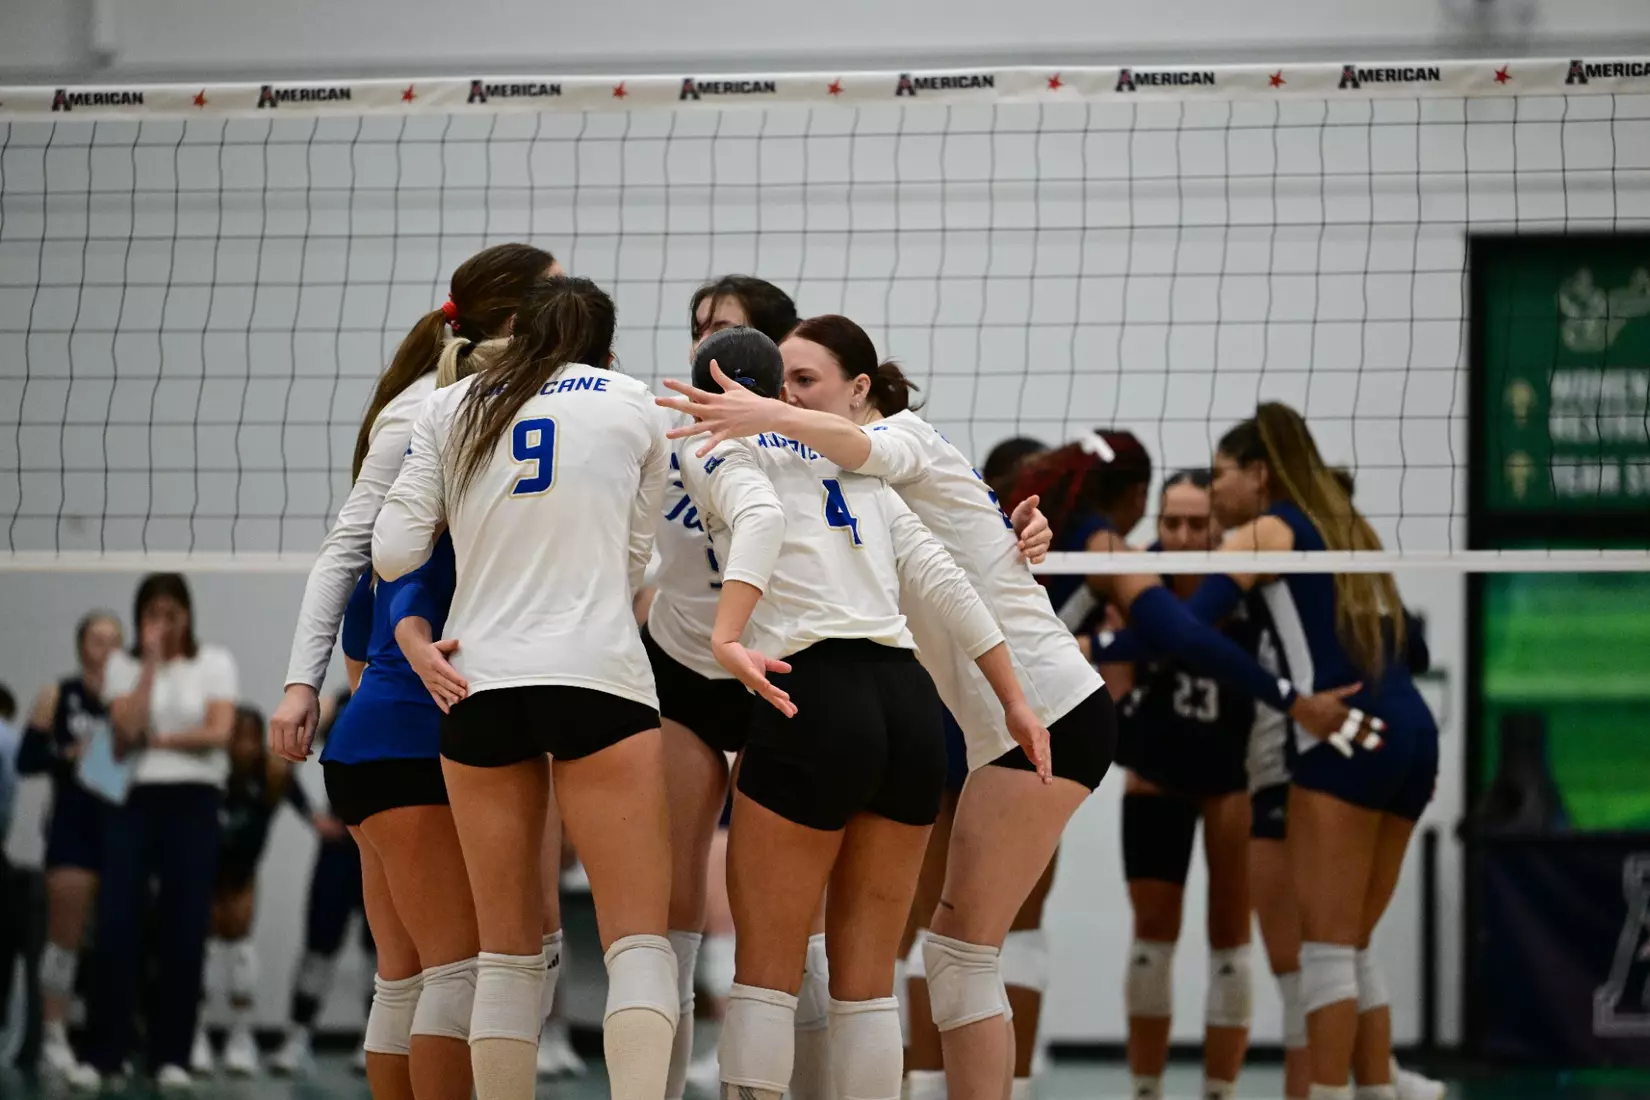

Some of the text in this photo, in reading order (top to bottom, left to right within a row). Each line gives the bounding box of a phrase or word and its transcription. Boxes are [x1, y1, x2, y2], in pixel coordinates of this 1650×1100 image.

[52, 60, 1650, 112] AMERICAN AMERICAN AMERICAN AMERICAN AMERICAN AMERICAN AMERICAN AMERICA
[510, 416, 559, 497] 9
[821, 477, 864, 547] 4
[1172, 672, 1219, 722] 23
